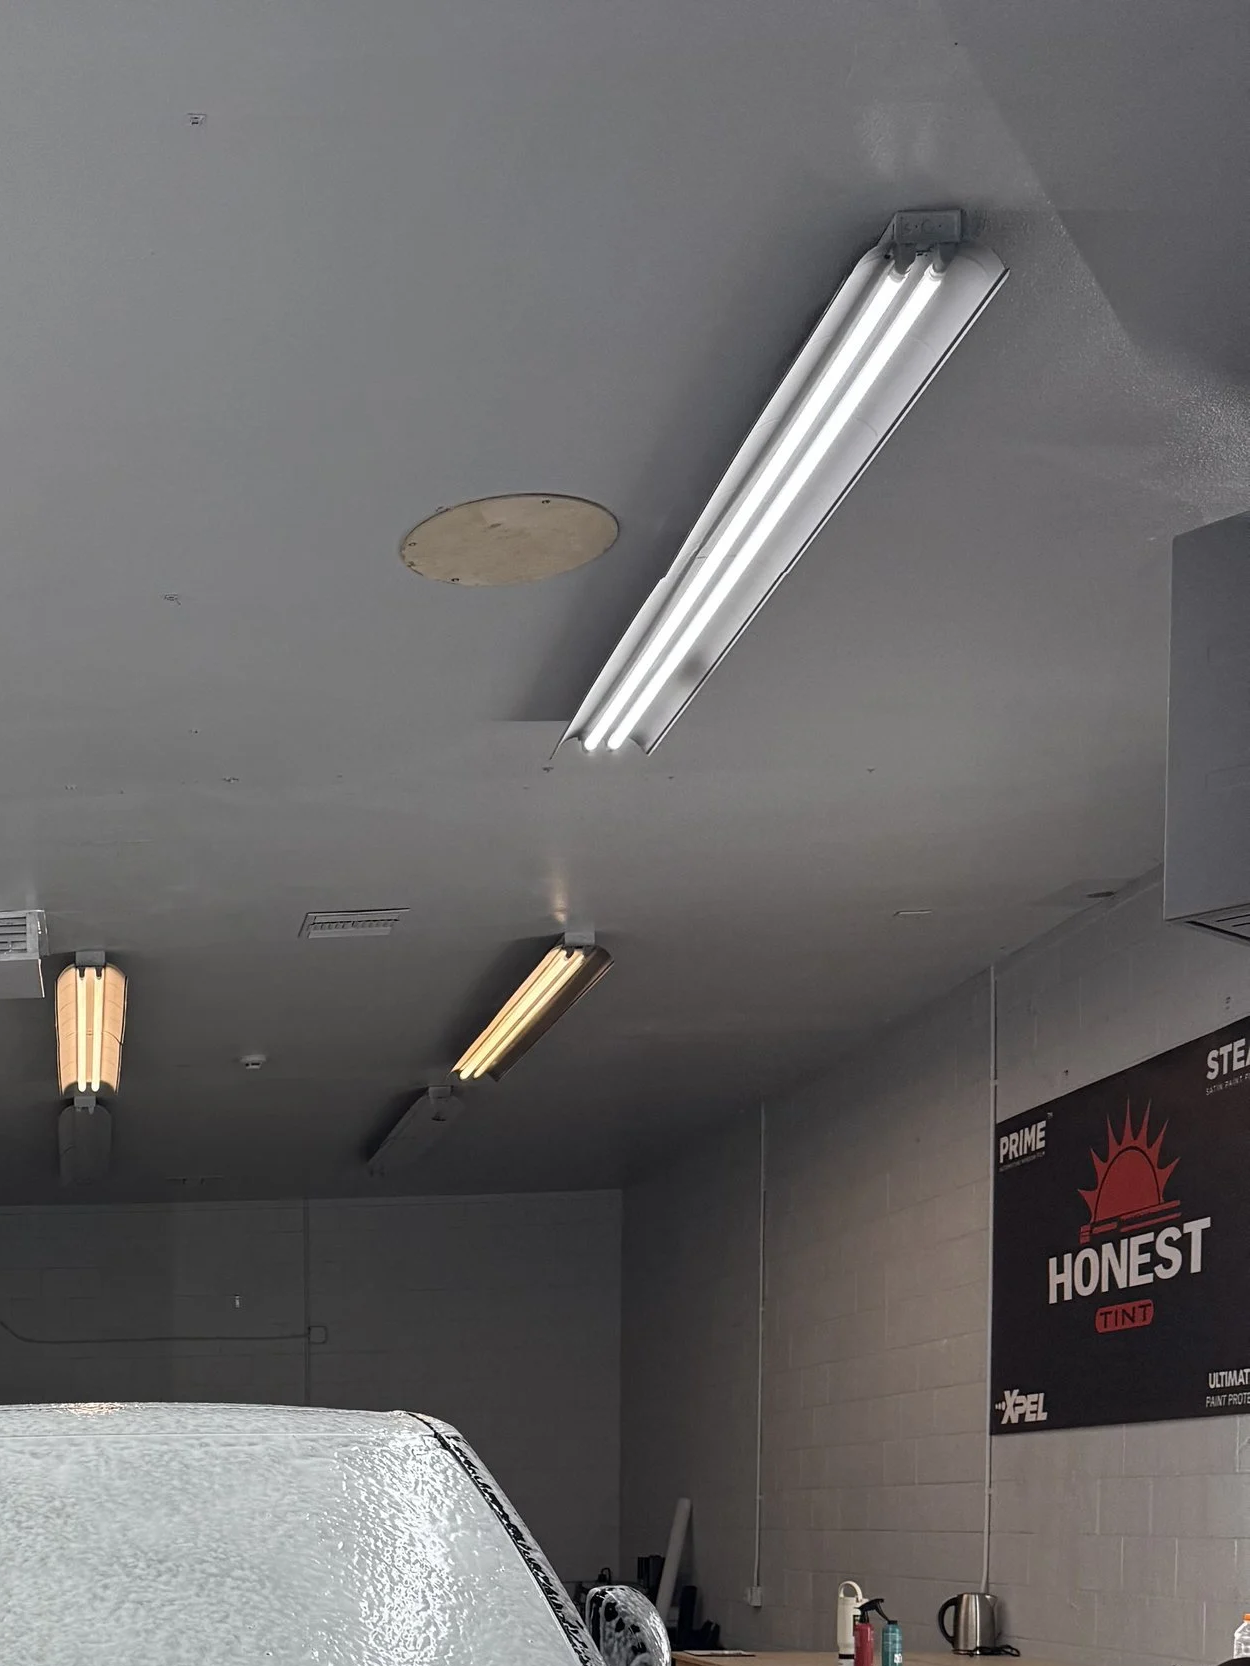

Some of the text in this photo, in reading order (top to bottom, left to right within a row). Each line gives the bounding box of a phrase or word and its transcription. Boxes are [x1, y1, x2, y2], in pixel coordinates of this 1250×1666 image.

[999, 1120, 1047, 1164] PRIME
[1048, 1216, 1211, 1305] HONEST
[1100, 1303, 1152, 1329] TINT
[998, 1389, 1048, 1425] XPEL
[1205, 1394, 1227, 1408] PAINT
